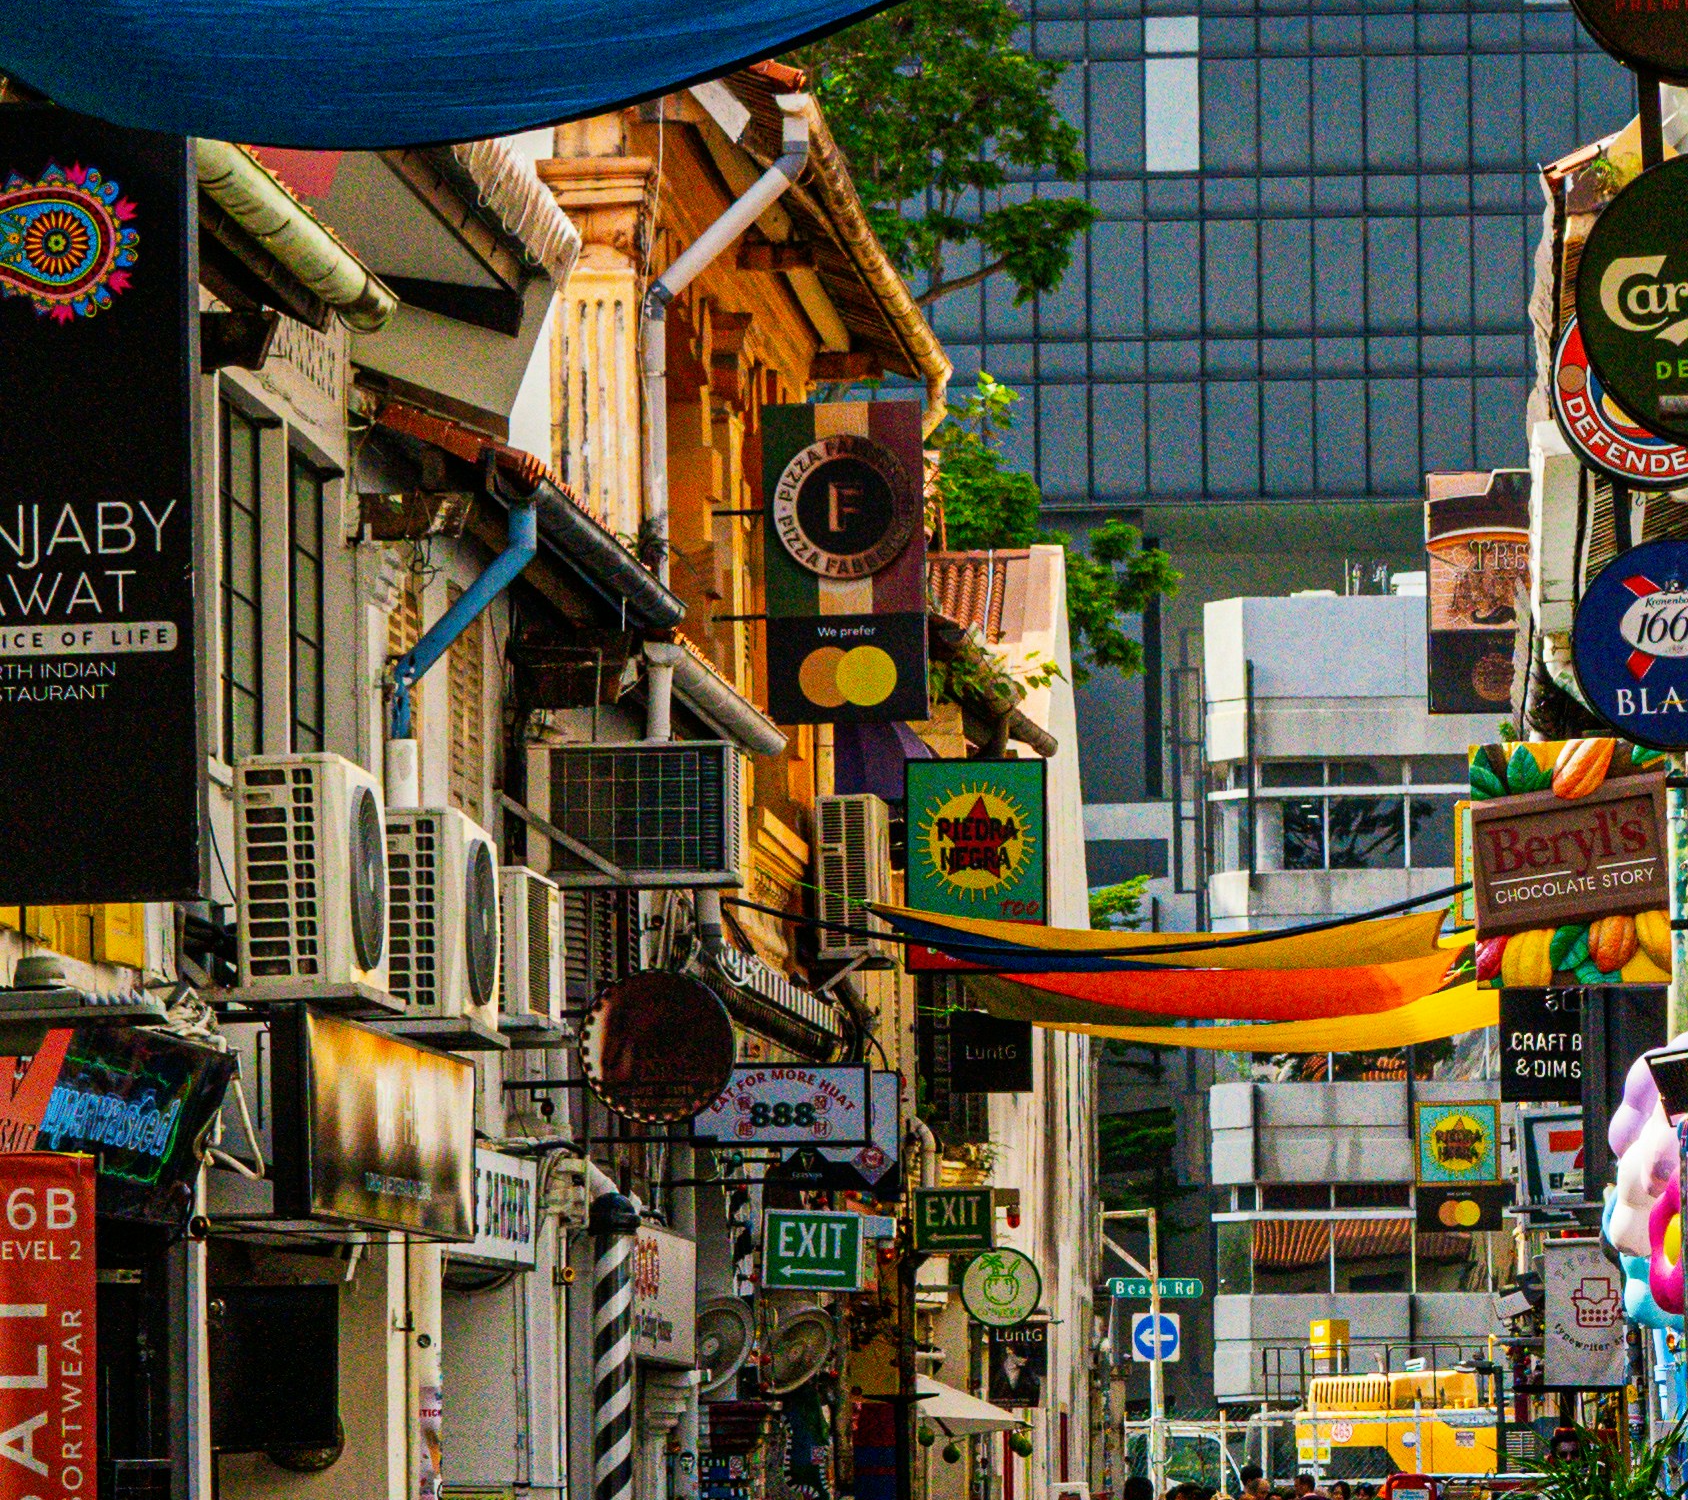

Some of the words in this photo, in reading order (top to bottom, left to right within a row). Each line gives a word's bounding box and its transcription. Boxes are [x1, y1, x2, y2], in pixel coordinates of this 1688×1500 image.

[778, 450, 822, 501] PIZZA
[0, 499, 177, 569] NJABY
[778, 515, 819, 567] PIZZA
[2, 632, 44, 649] ICE
[61, 630, 94, 647] OF
[111, 628, 168, 646] LIFE
[817, 627, 837, 637] We
[839, 626, 876, 638] prefer
[40, 661, 117, 679] INDIAN
[0, 684, 110, 701] TAURANT
[935, 816, 1020, 842] PIEDRA
[1486, 809, 1648, 877] Beryl's
[940, 846, 1012, 872] NEGRA
[1495, 876, 1597, 905] CHOCOLATE
[1602, 867, 1655, 888] STORY
[998, 901, 1040, 917] TOO
[1511, 1032, 1567, 1052] CRAFT
[1572, 1033, 1582, 1052] B
[1515, 1058, 1530, 1077] &
[1534, 1060, 1567, 1078] DIM
[1571, 1060, 1582, 1079] S
[710, 1088, 736, 1114] EAT
[736, 1072, 767, 1092] FOR
[770, 1069, 817, 1086] MORE
[818, 1079, 856, 1112] HUAT
[751, 1102, 818, 1128] 888
[925, 1196, 981, 1227] EXIT
[1, 1241, 62, 1260] EVEL
[69, 1241, 82, 1260] 2
[778, 1221, 847, 1259] EXIT
[1175, 1281, 1195, 1295] Rd
